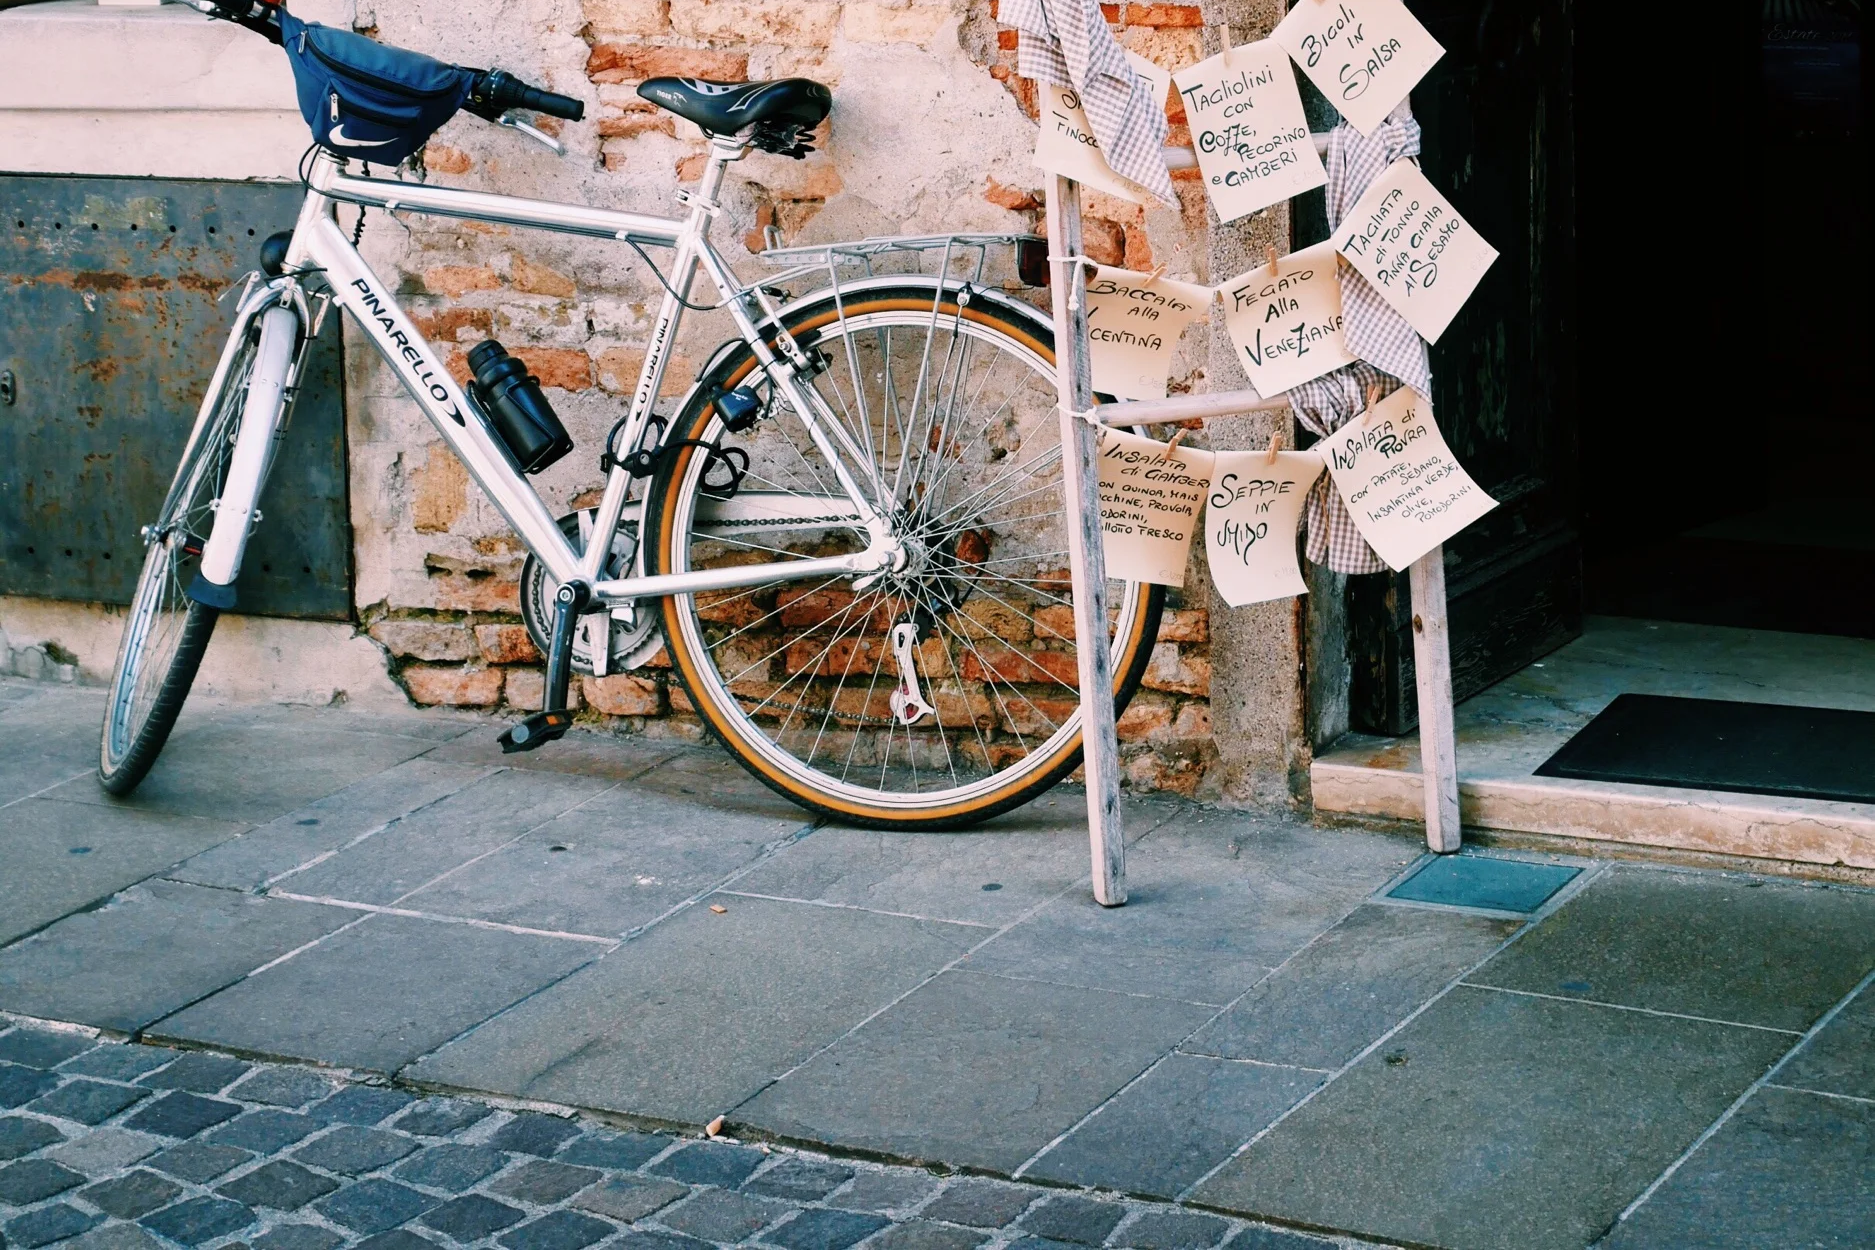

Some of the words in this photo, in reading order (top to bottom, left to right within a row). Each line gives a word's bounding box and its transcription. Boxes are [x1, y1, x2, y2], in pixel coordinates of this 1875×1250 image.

[1347, 23, 1364, 49] IN
[1223, 97, 1254, 118] CON
[1237, 127, 1306, 163] PECORINO
[1381, 200, 1420, 244] TONNO
[1377, 251, 1411, 287] PINNA
[1232, 270, 1314, 313] FEGATO
[350, 277, 449, 402] PINARELLO
[638, 317, 669, 404] PINARELLO
[1098, 481, 1115, 489] ON
[1122, 484, 1166, 499] QUINOA,
[1210, 473, 1296, 509] SEPPIE
[1255, 499, 1276, 515] IN
[1350, 484, 1369, 504] CON
[1137, 524, 1184, 542] FRESCO
